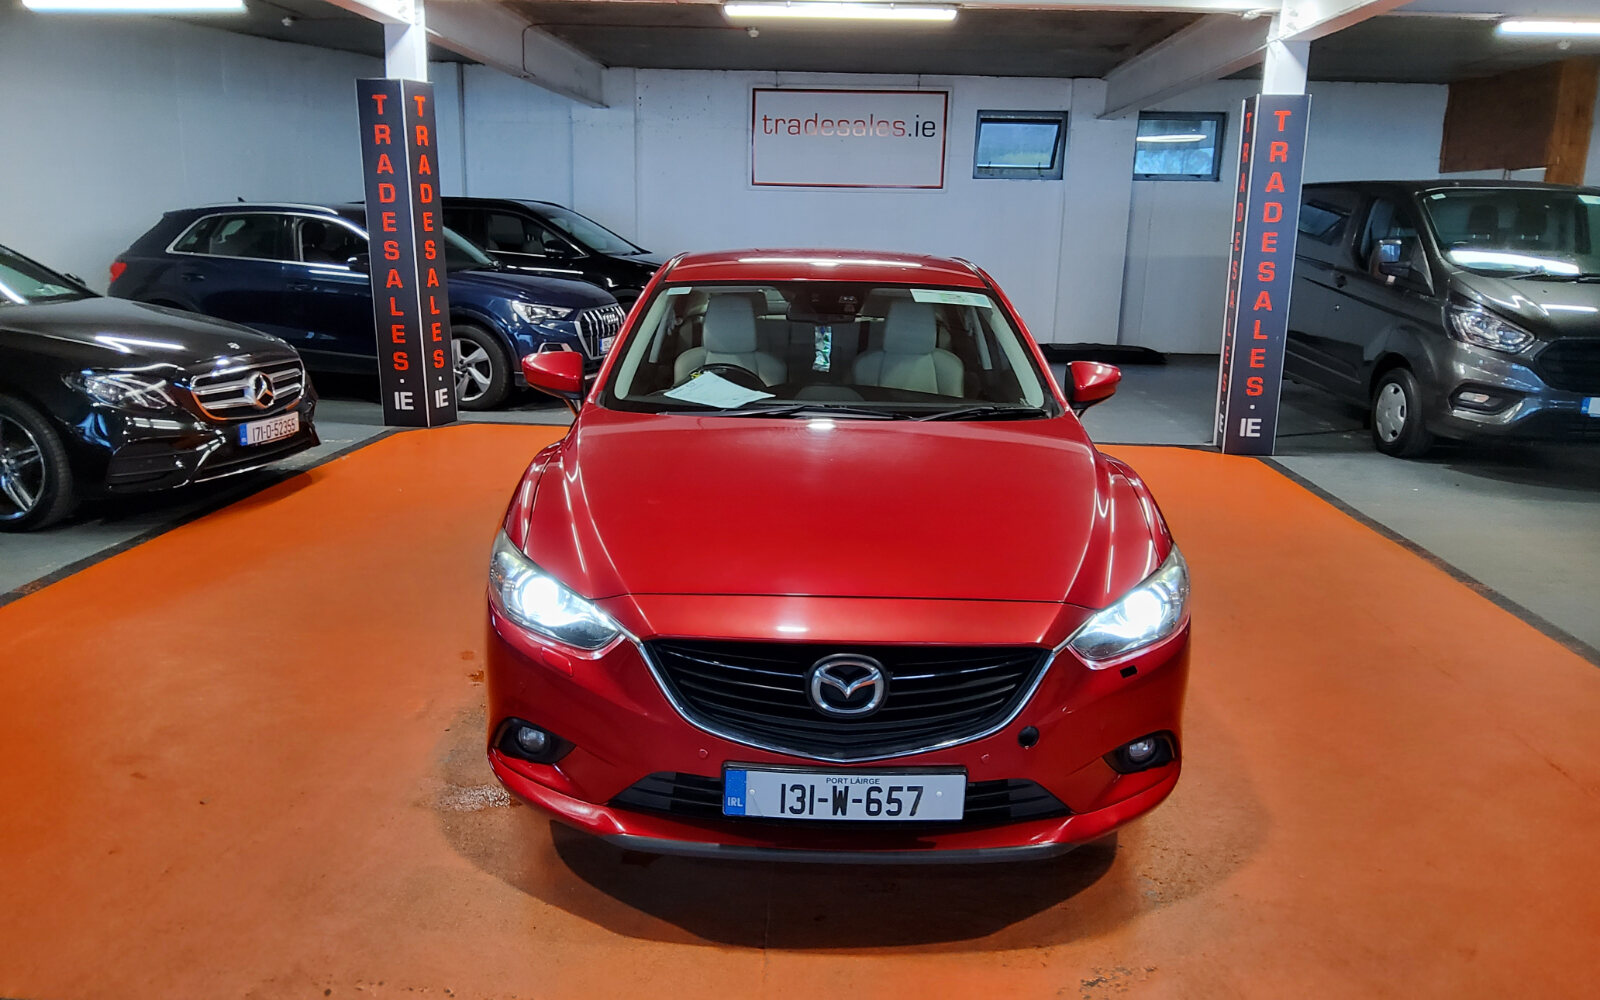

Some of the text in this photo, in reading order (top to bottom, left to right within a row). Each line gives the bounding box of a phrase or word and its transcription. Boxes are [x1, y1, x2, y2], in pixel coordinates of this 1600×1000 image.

[762, 113, 936, 138] tradesales.ie
[850, 777, 881, 785] LÁIRGE
[727, 796, 744, 807] IRL
[779, 784, 924, 817] 131-W-657
